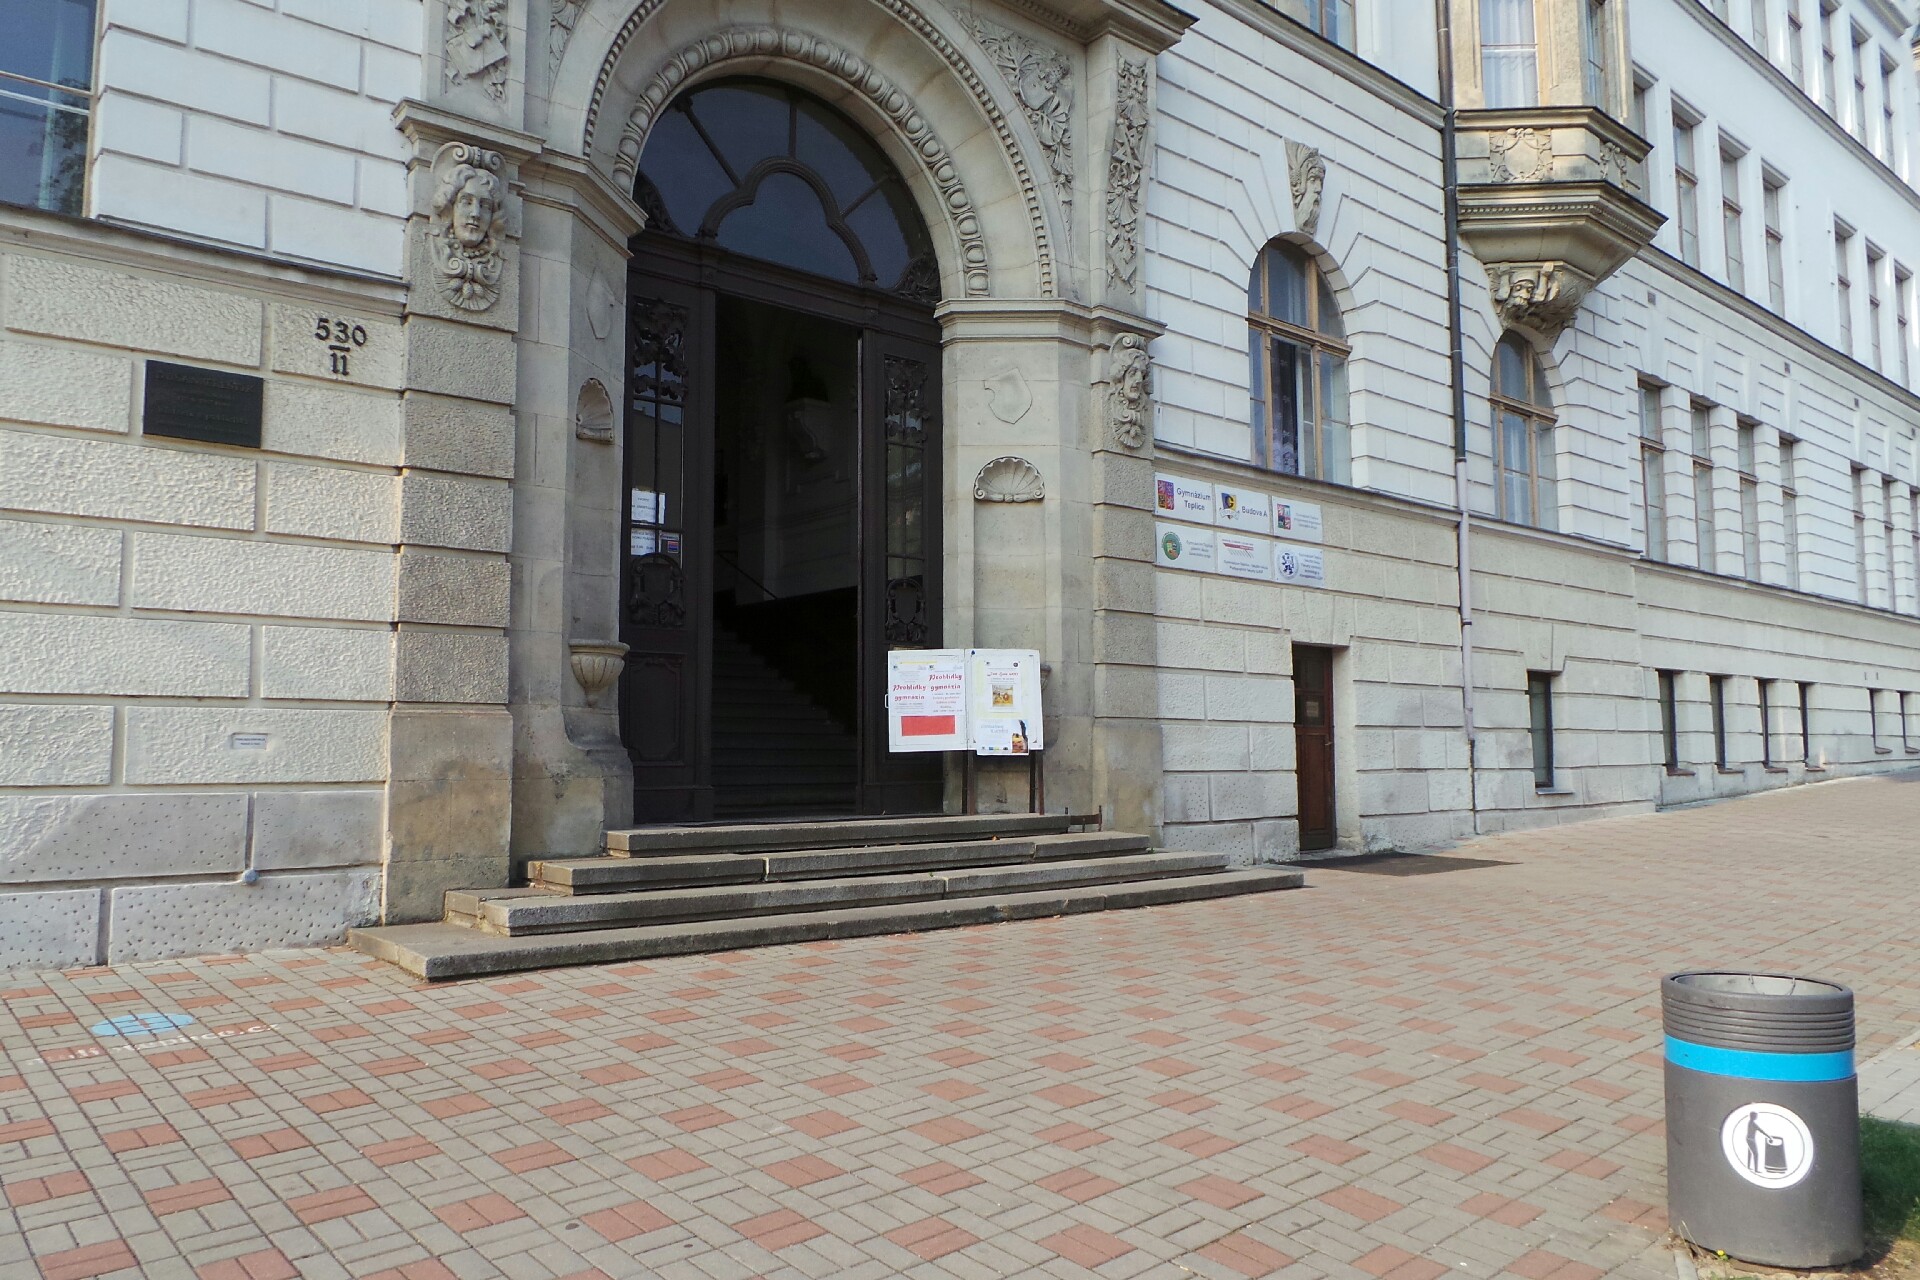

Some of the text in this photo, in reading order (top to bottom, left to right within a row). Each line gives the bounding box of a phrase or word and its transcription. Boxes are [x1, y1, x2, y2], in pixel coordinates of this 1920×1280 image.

[314, 317, 367, 347] 530
[330, 352, 350, 376] 11
[1176, 487, 1211, 501] Gymnázium
[1183, 499, 1206, 511] Teplice
[1241, 505, 1269, 517] Budova A
